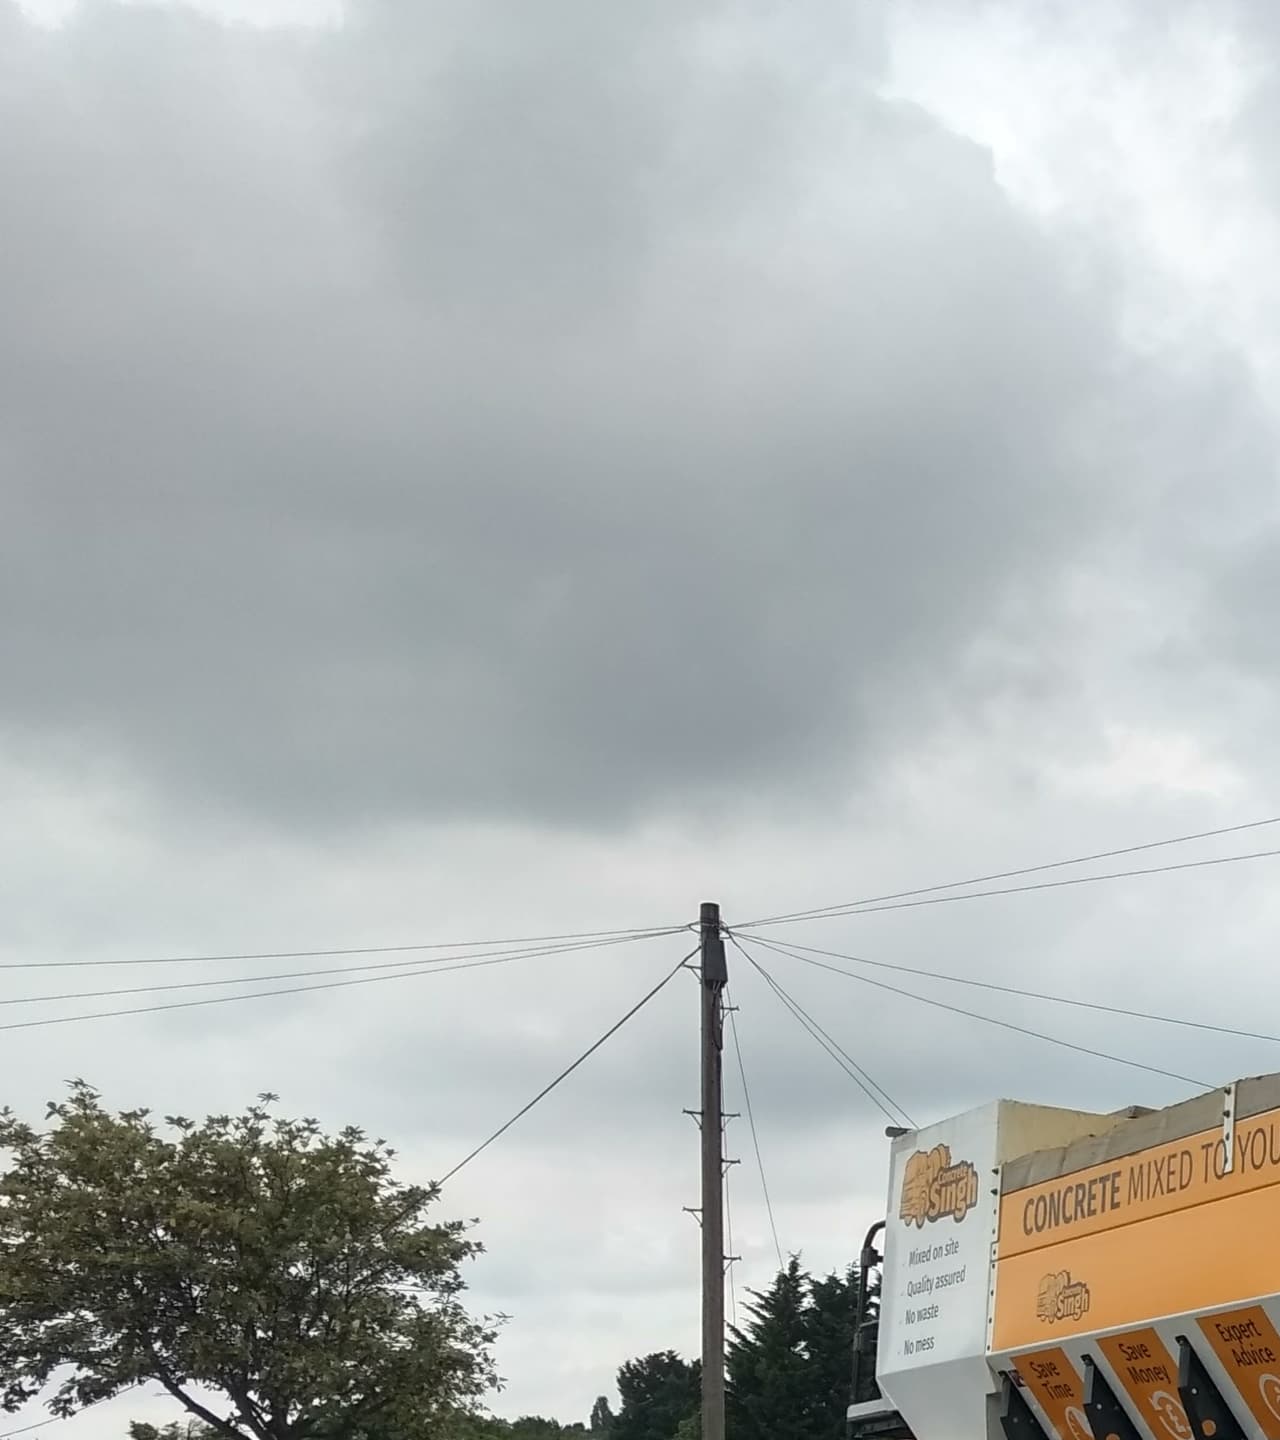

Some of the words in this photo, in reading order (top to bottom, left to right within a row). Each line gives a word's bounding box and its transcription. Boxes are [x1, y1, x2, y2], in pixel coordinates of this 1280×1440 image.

[928, 1167, 977, 1218] Singh
[1023, 1170, 1122, 1236] CONCRETE
[1127, 1150, 1194, 1206] MIXED
[908, 1244, 932, 1267] Mixed
[932, 1246, 943, 1260] on
[944, 1237, 960, 1256] site
[907, 1274, 934, 1298] Quality
[935, 1264, 966, 1290] assured
[1056, 1286, 1089, 1320] Singh
[905, 1309, 916, 1325] No
[917, 1304, 939, 1322] waste
[1215, 1319, 1262, 1345] Expert
[904, 1339, 915, 1356] No
[915, 1336, 935, 1353] mess
[1118, 1343, 1151, 1361] Save
[1232, 1345, 1277, 1367] Advice
[1030, 1361, 1060, 1379] Save
[1127, 1365, 1172, 1385] Money
[1041, 1381, 1074, 1400] Time
